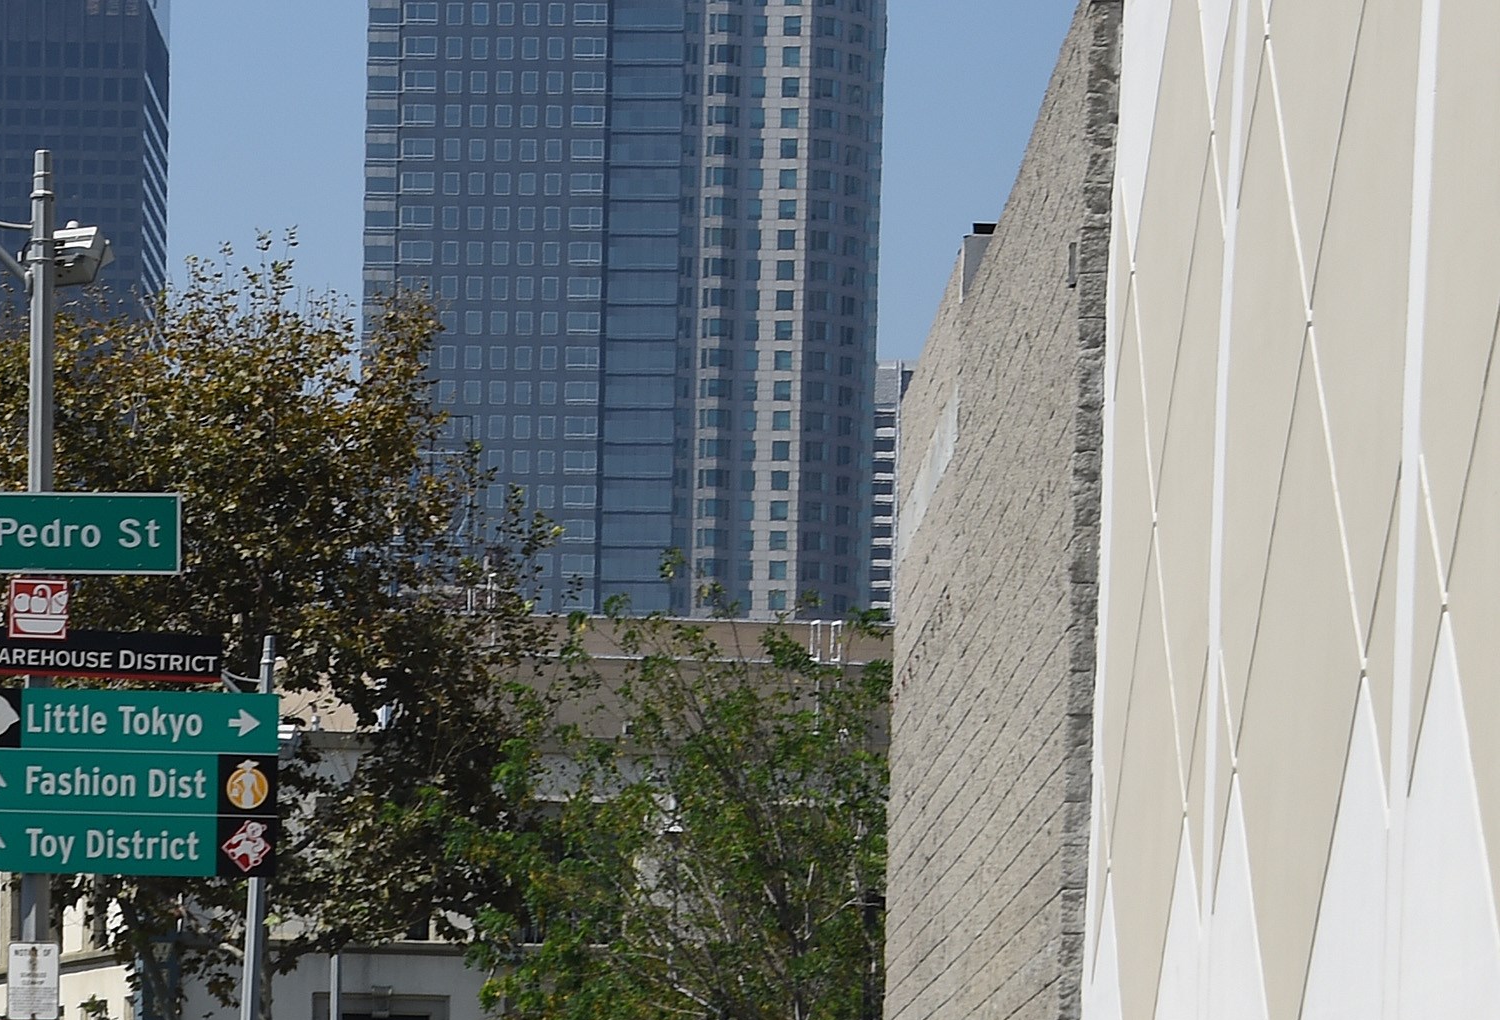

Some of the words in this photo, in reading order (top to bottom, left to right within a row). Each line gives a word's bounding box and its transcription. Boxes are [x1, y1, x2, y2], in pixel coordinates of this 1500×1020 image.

[119, 518, 160, 548] St
[119, 649, 217, 672] DISTRICT
[27, 703, 107, 734] Little
[118, 705, 203, 742] Tokyo
[25, 765, 135, 797] Fashion
[148, 768, 206, 799] Dist
[25, 827, 75, 864] Toy
[87, 828, 199, 861] District
